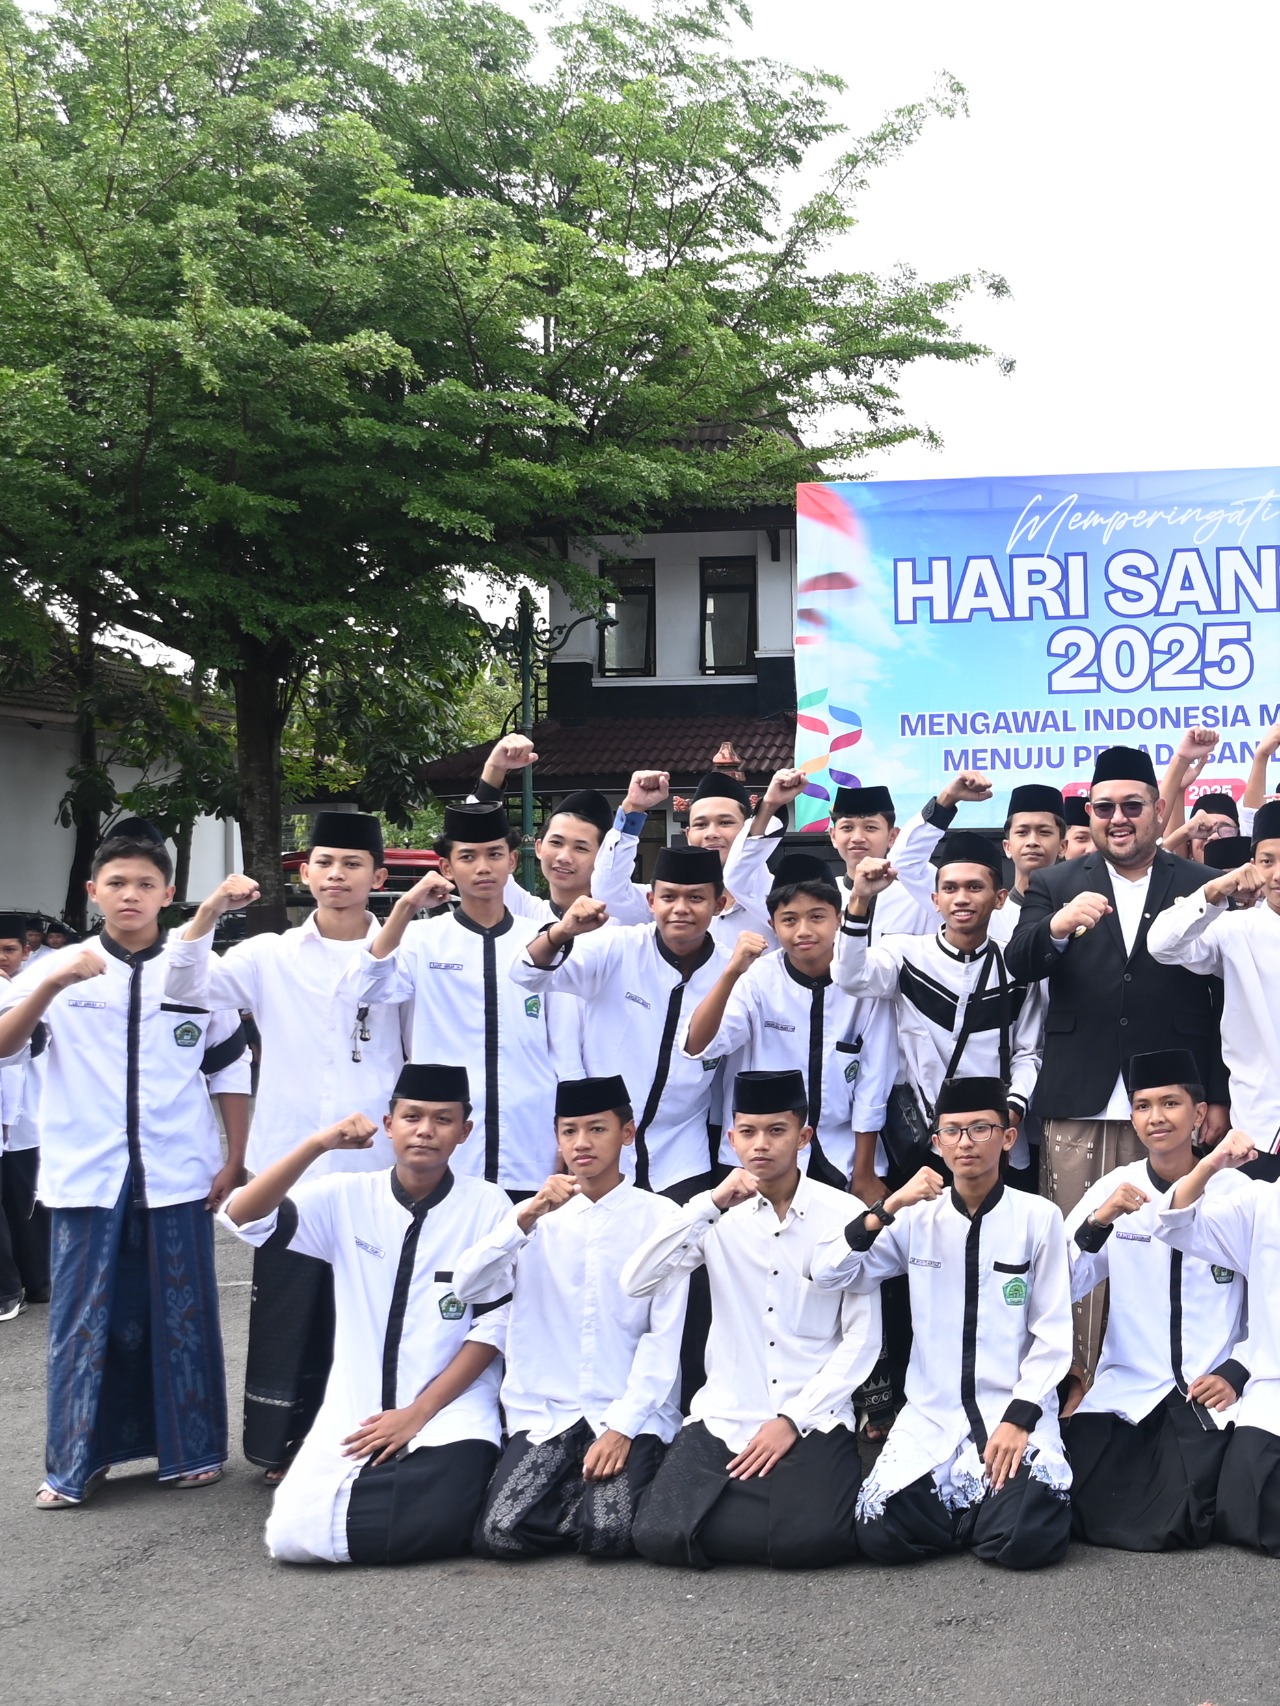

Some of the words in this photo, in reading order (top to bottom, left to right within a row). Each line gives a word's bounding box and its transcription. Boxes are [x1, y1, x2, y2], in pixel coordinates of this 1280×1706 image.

[893, 552, 1089, 624] HARI
[1047, 621, 1254, 694] 2025
[900, 709, 1077, 736] MENGAWAL
[1084, 705, 1251, 731] INDONESIA
[943, 746, 1065, 772] MENUJU
[1188, 784, 1233, 800] 2025
